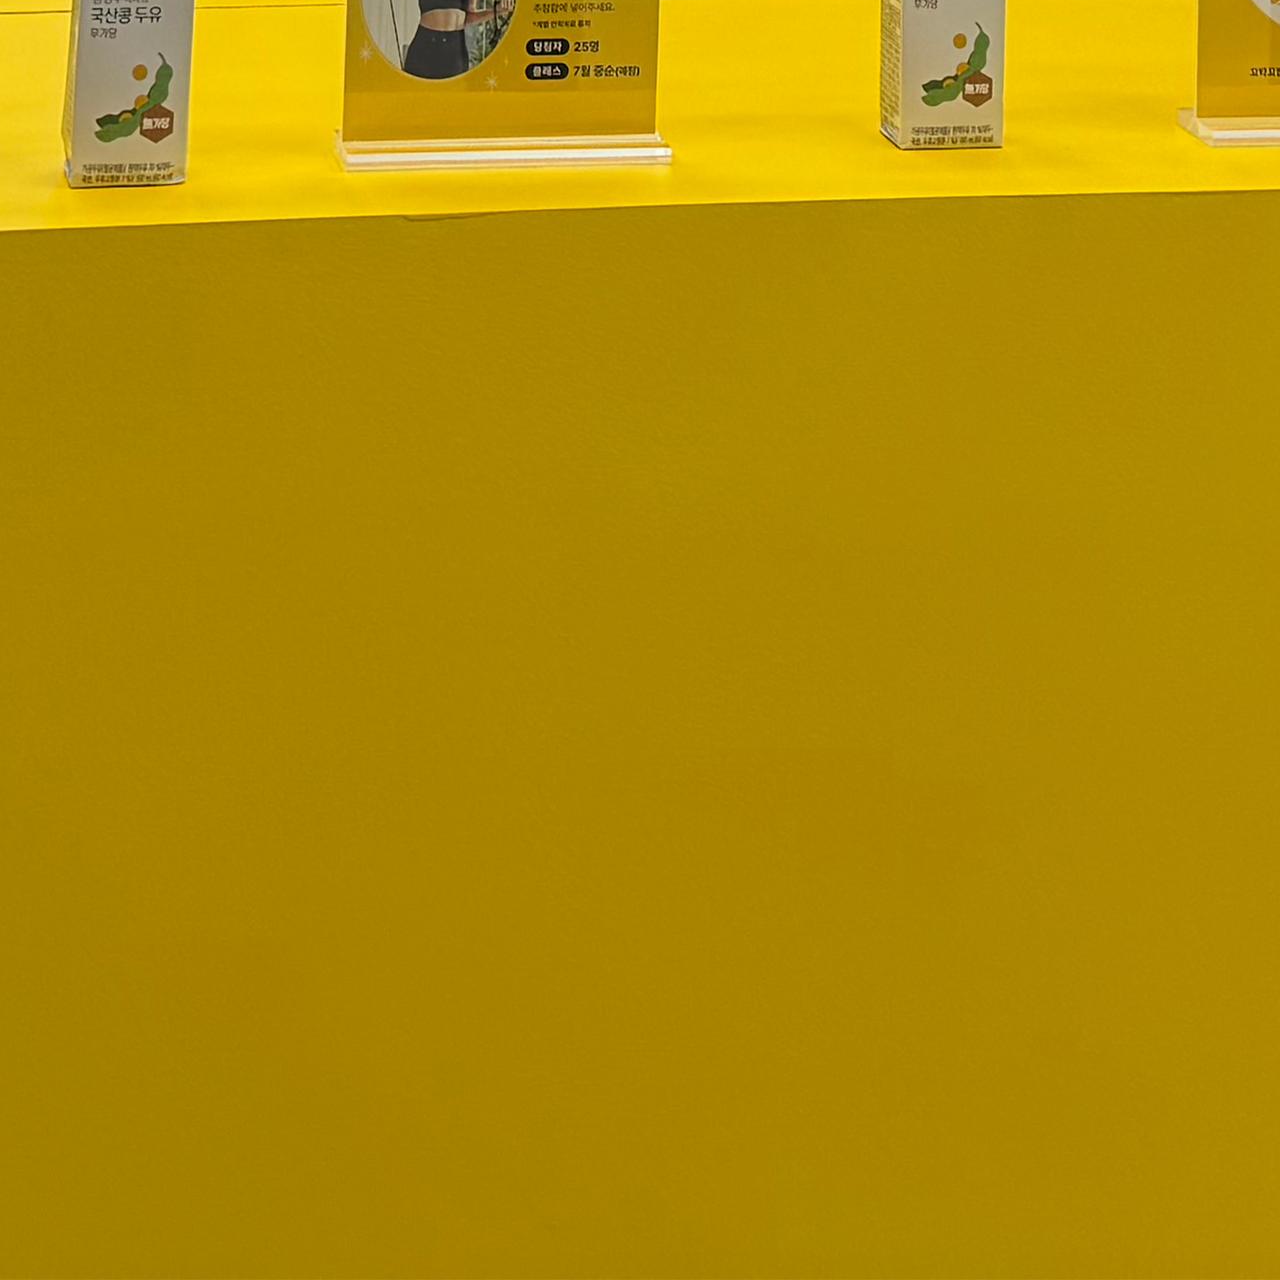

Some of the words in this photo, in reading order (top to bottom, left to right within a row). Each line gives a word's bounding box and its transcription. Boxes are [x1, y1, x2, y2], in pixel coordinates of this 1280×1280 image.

[91, 6, 132, 24] 국산콩
[135, 6, 162, 24] 두유
[574, 40, 599, 53] 25명
[573, 65, 591, 77] 7월
